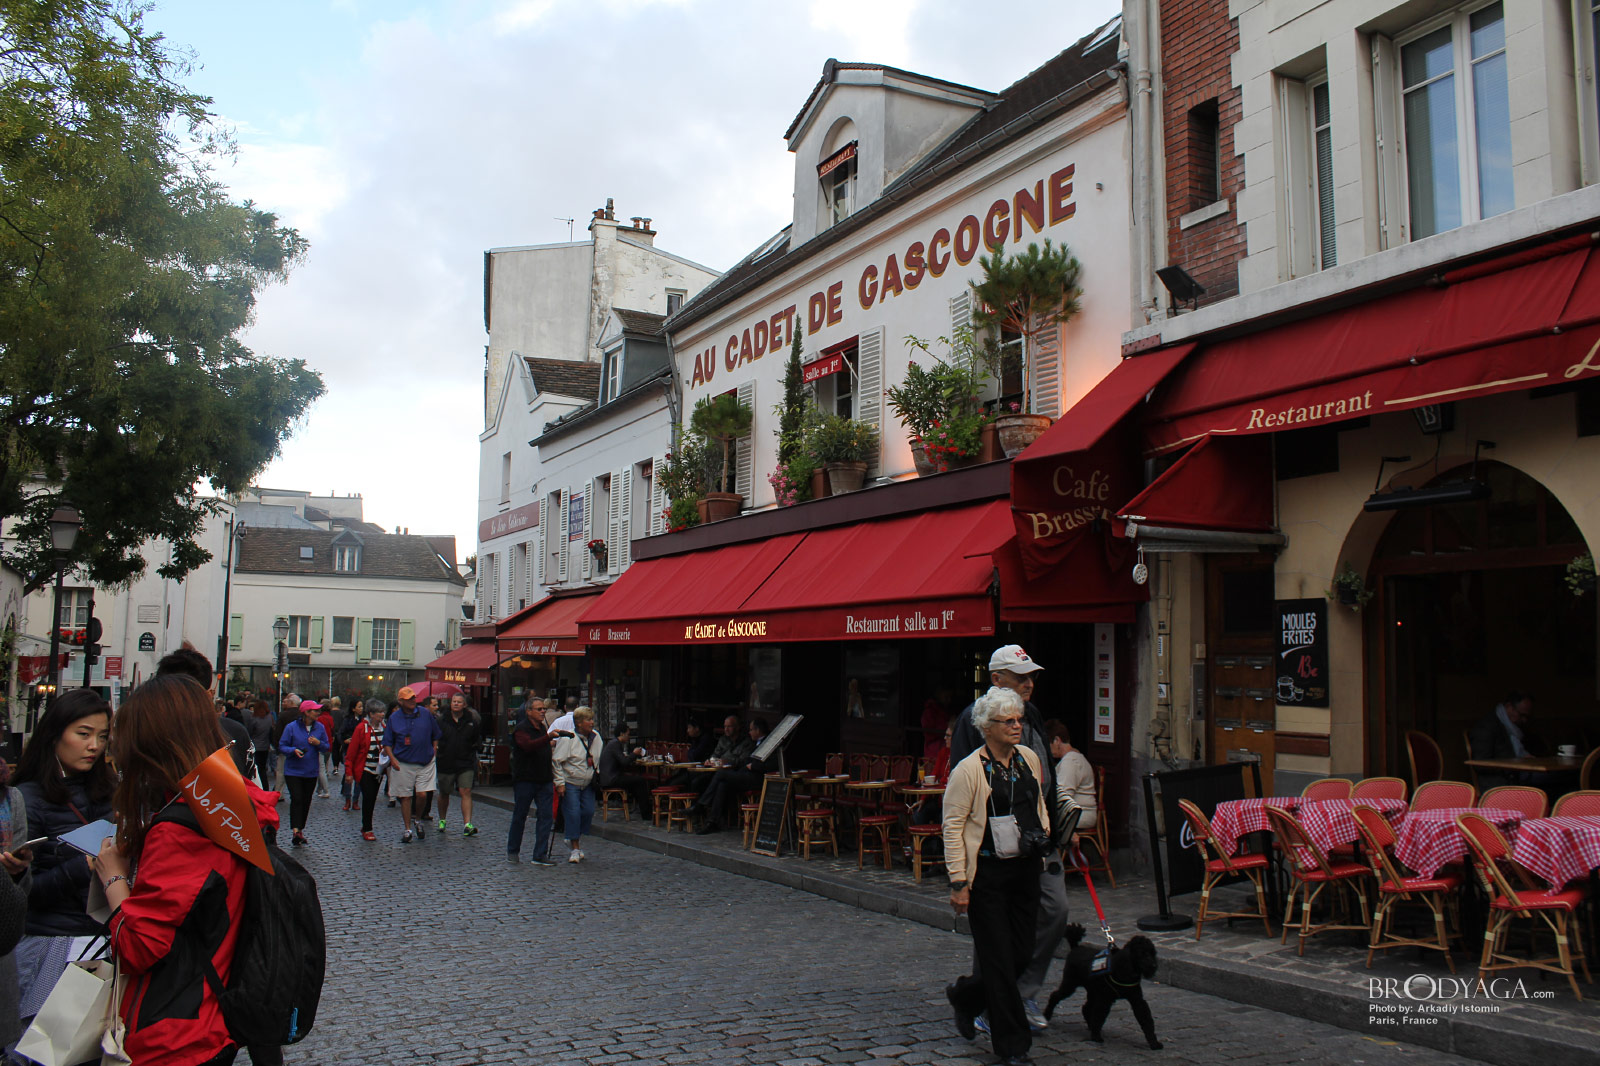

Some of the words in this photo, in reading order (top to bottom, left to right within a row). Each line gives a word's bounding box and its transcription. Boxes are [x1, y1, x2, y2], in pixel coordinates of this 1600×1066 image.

[691, 345, 716, 390] AU
[724, 303, 797, 373] CADET
[807, 280, 844, 337] DE
[858, 162, 1077, 311] GASCOGNE
[1246, 389, 1374, 430] Restaurant
[1052, 465, 1110, 501] Café
[589, 628, 601, 641] Café
[607, 627, 631, 641] Brasserie
[684, 625, 694, 639] AU
[694, 621, 717, 639] CADET
[717, 625, 726, 638] de
[727, 618, 767, 637] GASCOGNE
[845, 614, 900, 634] Restaurant
[904, 611, 927, 632] salle
[928, 616, 939, 631] au
[1281, 611, 1317, 630] MOULES
[220, 806, 250, 852] Paris
